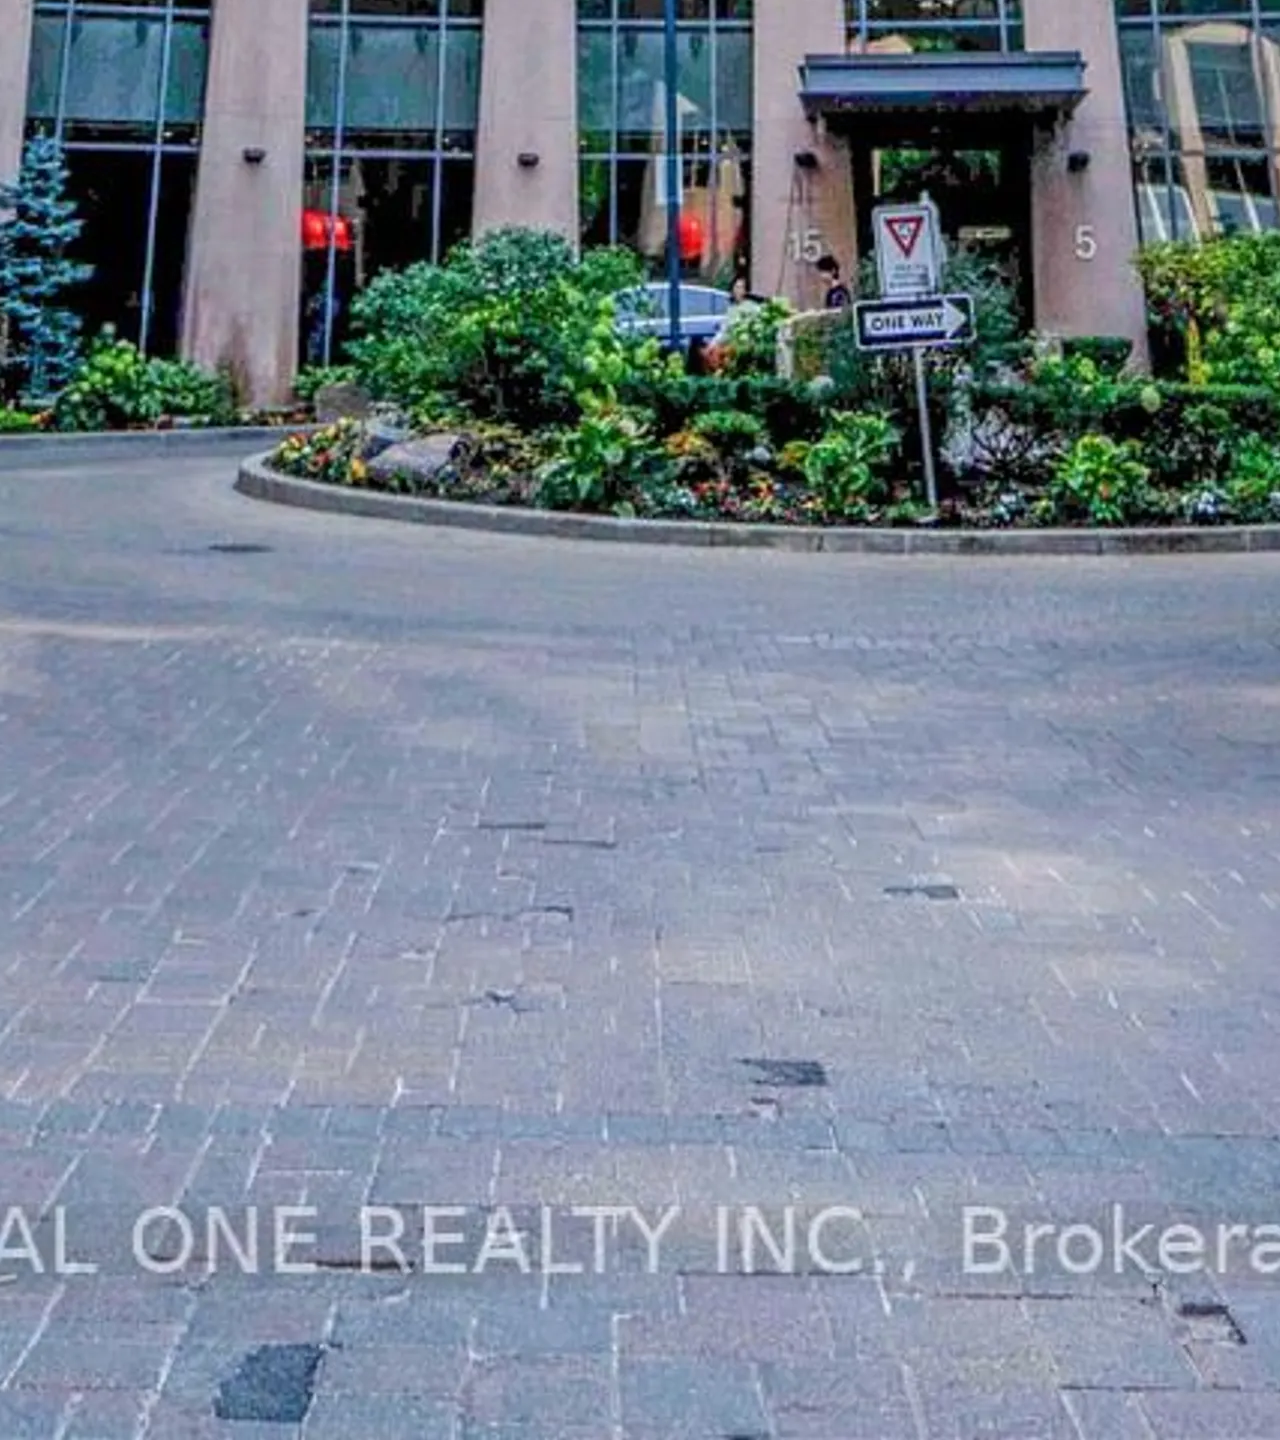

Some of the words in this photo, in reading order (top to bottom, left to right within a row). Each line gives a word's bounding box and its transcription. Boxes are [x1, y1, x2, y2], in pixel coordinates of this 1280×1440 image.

[788, 230, 822, 261] 15
[1074, 225, 1097, 259] 5
[872, 316, 906, 331] ONE
[910, 311, 944, 328] WAY
